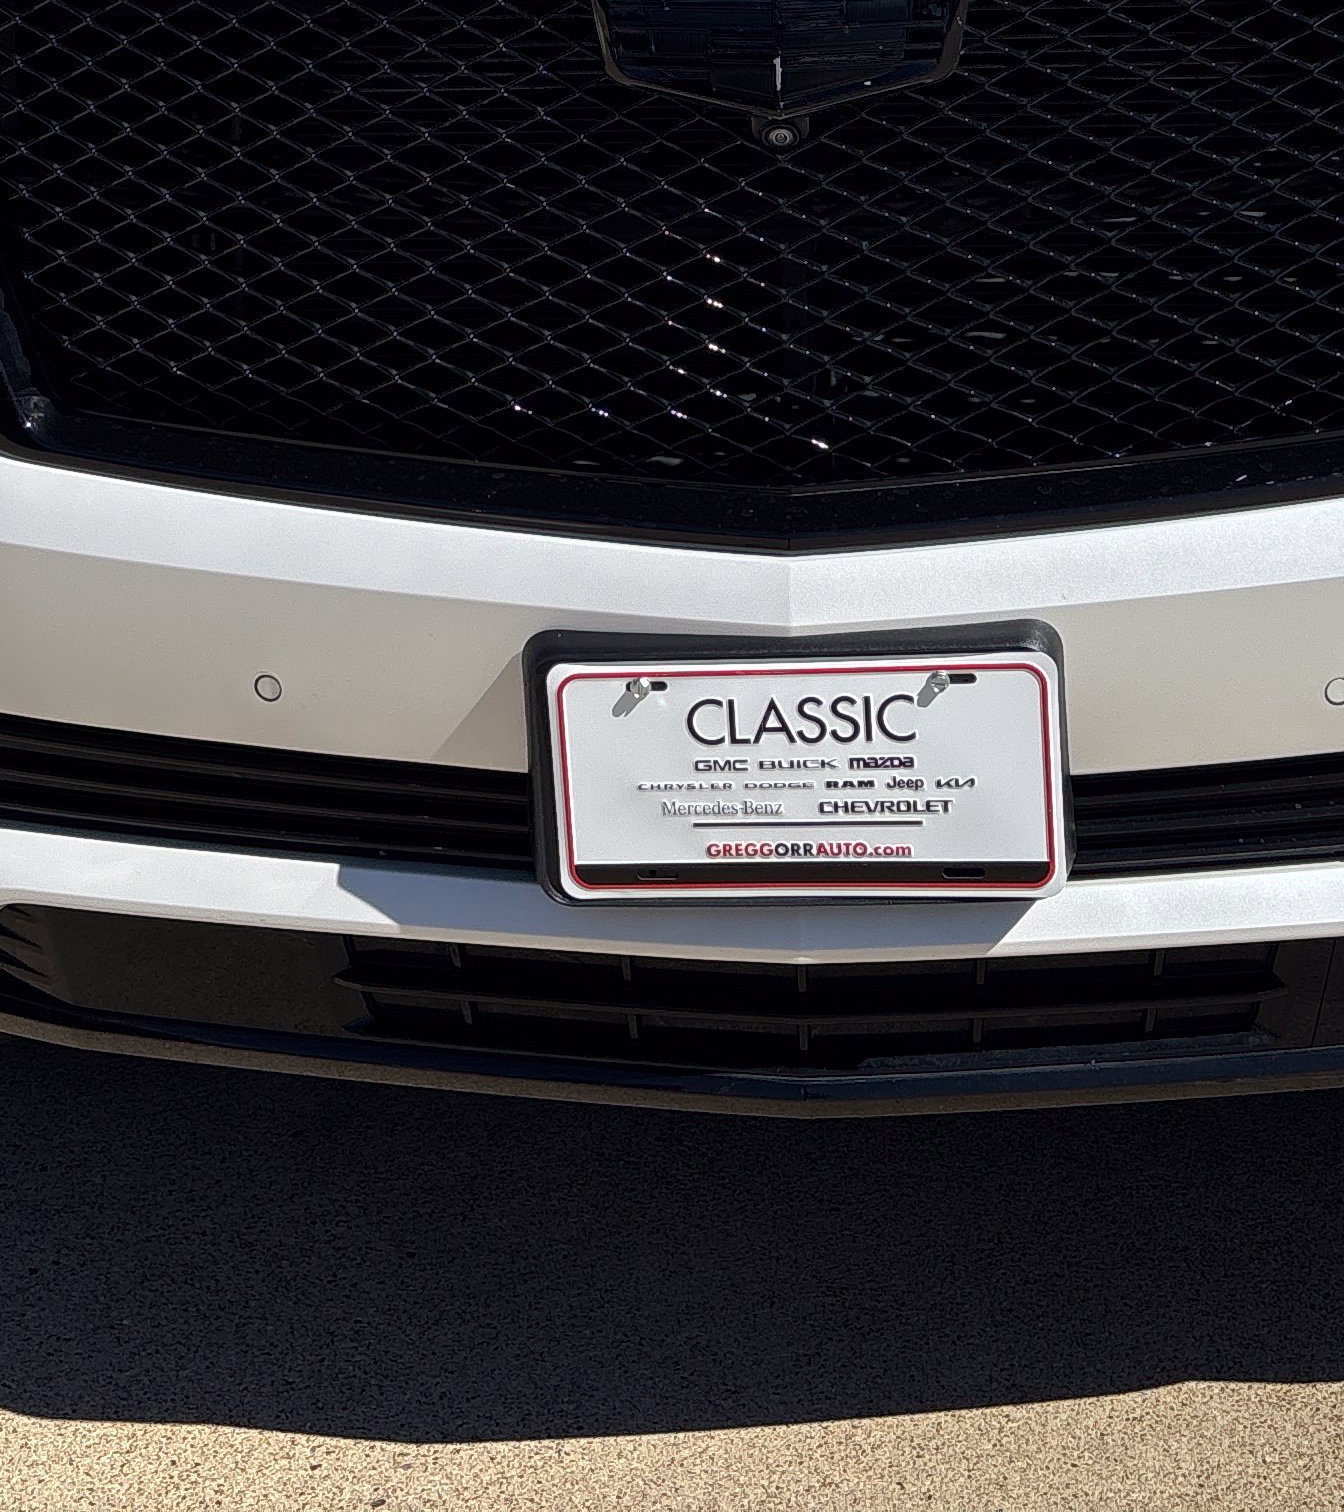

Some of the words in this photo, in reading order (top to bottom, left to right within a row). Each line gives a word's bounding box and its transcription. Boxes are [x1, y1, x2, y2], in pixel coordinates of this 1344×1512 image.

[686, 694, 917, 746] CLASSIC
[694, 759, 749, 772] GMC
[759, 758, 840, 770] BUICK
[848, 756, 915, 770] mazda
[637, 782, 733, 791] CHRYSLER
[744, 781, 815, 791] DODGE
[826, 779, 875, 789] RAM
[887, 775, 924, 791] Jeep
[662, 800, 783, 817] Mercedes-Benz
[818, 799, 954, 815] CHEVROLET
[706, 842, 913, 858] GREGGORRAUTO.com
